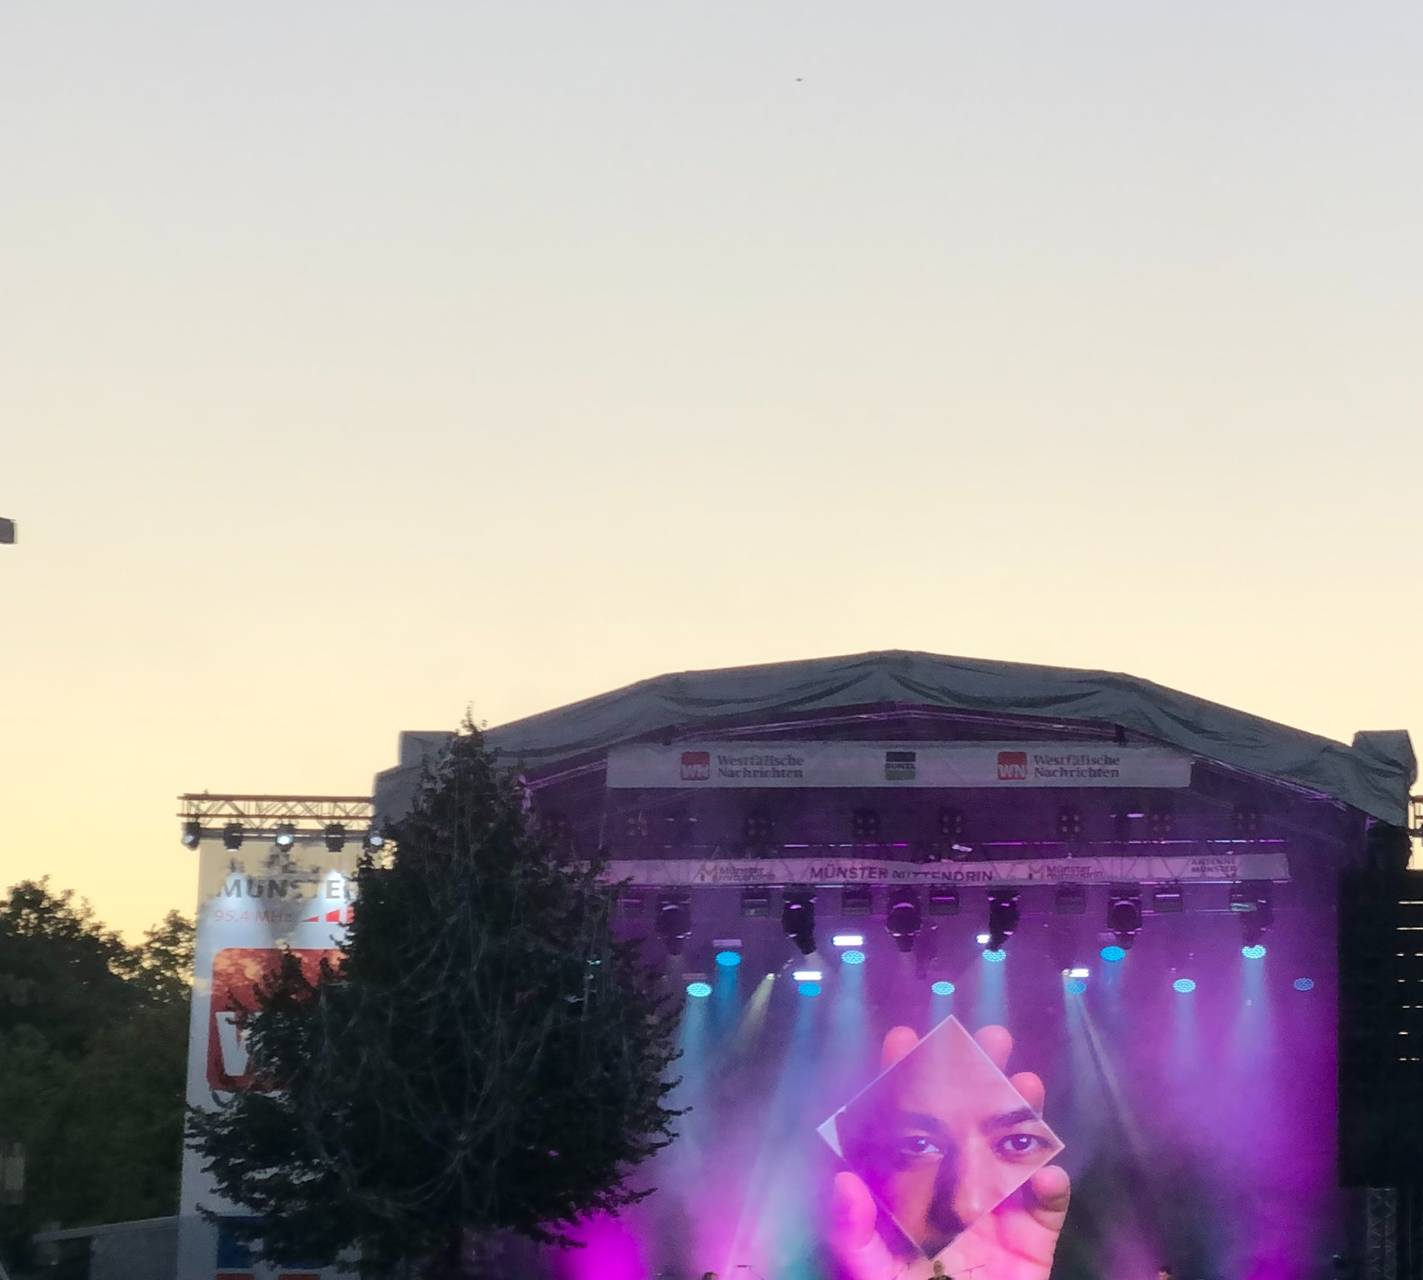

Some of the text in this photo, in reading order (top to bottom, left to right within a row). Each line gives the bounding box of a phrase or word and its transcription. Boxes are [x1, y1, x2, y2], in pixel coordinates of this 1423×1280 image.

[717, 754, 804, 766] Westfälische
[1034, 754, 1120, 766] Westfälische
[718, 767, 804, 778] Nachrichten
[998, 764, 1027, 779] WN
[1034, 767, 1120, 778] Nachrichten
[810, 864, 993, 882] MÜNSTER MITTENDRIN
[215, 911, 250, 922] 95.4
